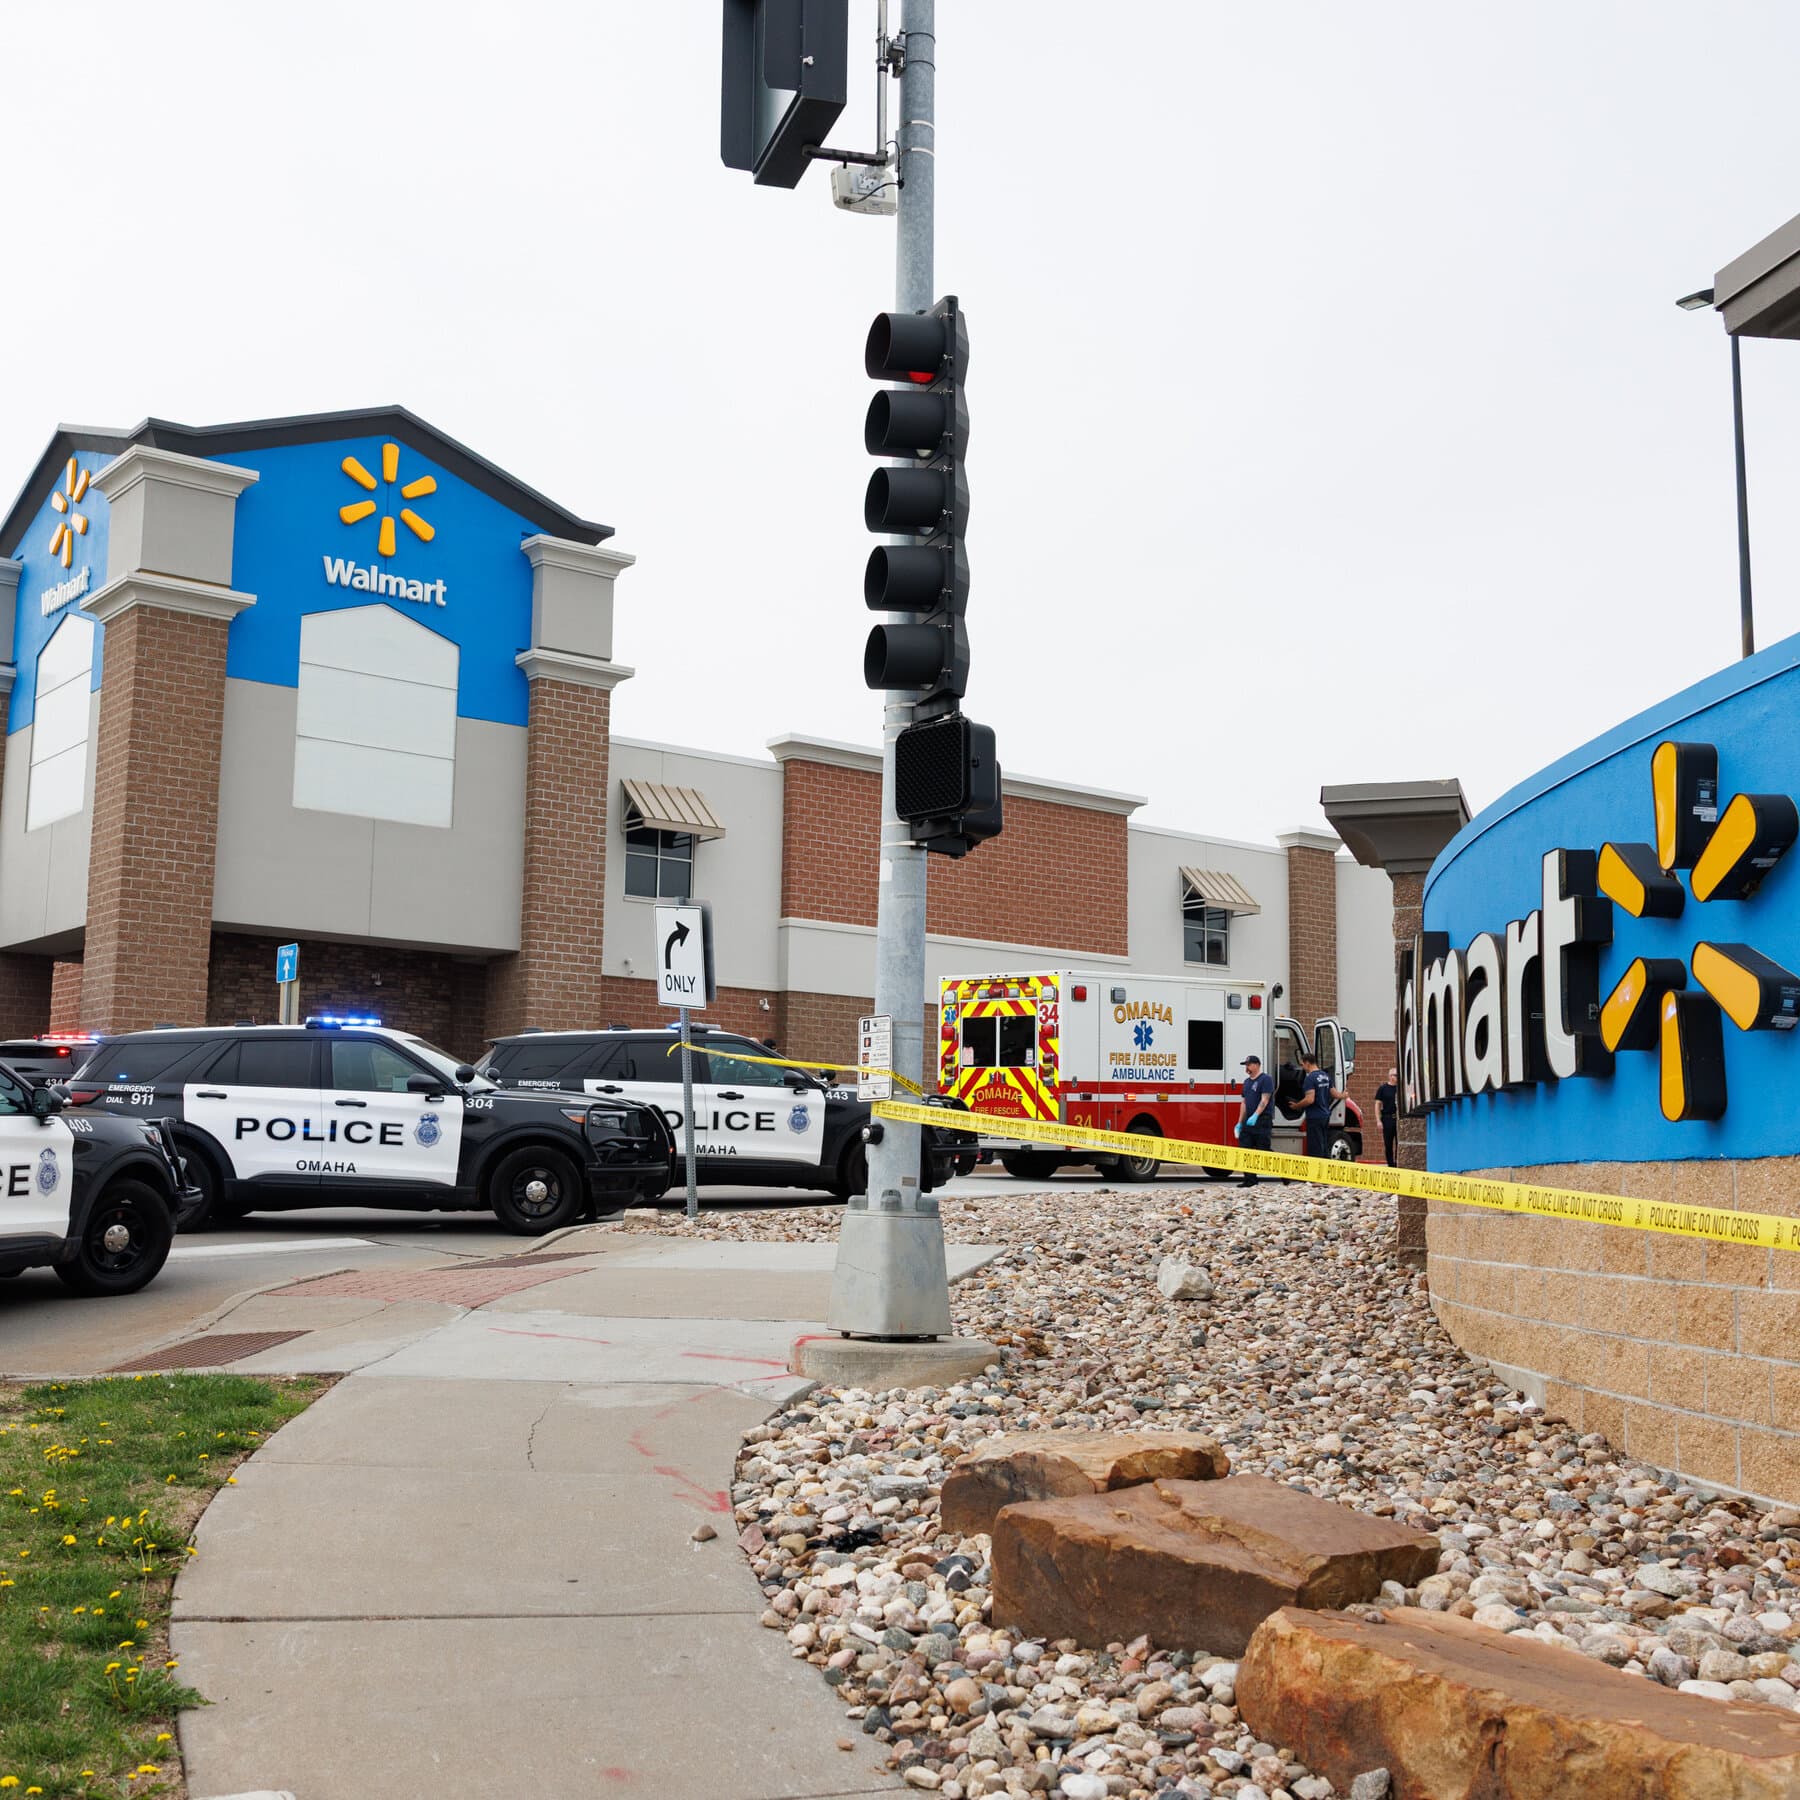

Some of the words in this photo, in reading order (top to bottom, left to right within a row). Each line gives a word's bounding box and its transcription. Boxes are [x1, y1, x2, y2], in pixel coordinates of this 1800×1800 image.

[322, 555, 447, 607] Walmart
[41, 565, 91, 617] Walmart
[665, 974, 696, 993] ONLY
[1396, 848, 1577, 1114] almart
[1039, 1003, 1059, 1024] 34
[1114, 1000, 1174, 1026] OMAHA
[1109, 1052, 1131, 1066] FIRE
[1138, 1052, 1177, 1067] RESCUE
[1112, 1068, 1175, 1081] AMBULANCE
[108, 1084, 156, 1092] EMERGENCY
[825, 1091, 849, 1101] 443
[976, 1087, 1020, 1104] OMAHA
[106, 1096, 124, 1104] DIAL
[130, 1093, 154, 1106] 911
[466, 1098, 494, 1109] 304
[975, 1106, 988, 1115] FIRE
[994, 1107, 1020, 1115] RESCUE
[68, 1118, 93, 1133] 403
[664, 1110, 776, 1132] OLICE
[1074, 1114, 1092, 1128] 34
[234, 1117, 404, 1146] POLICE
[695, 1144, 737, 1155] MAHA
[296, 1159, 357, 1174] OMAHA
[1243, 1153, 1260, 1169] POLICE
[1261, 1156, 1272, 1171] LINE
[1272, 1156, 1280, 1172] DO
[1281, 1158, 1292, 1174] NOT
[1292, 1160, 1309, 1177] CROSS
[1327, 1164, 1345, 1182] POLICE
[1346, 1167, 1358, 1184] LINE
[1359, 1169, 1367, 1185] DO
[1368, 1170, 1380, 1187] NOT
[1381, 1171, 1400, 1190] CROSS
[1420, 1176, 1442, 1196] POLICE
[1443, 1180, 1457, 1197] LINE
[1458, 1182, 1467, 1199] DO
[1468, 1183, 1482, 1201] NOT
[1482, 1185, 1504, 1205] CROSS
[1528, 1190, 1552, 1212] POLICE
[1553, 1195, 1568, 1214] LINE
[1570, 1197, 1580, 1215] DO
[1582, 1198, 1597, 1217] NOT
[1598, 1200, 1623, 1222] CROSS
[1650, 1206, 1678, 1228] POLICE
[1678, 1212, 1696, 1232] LINE
[1698, 1213, 1710, 1233] DO
[1712, 1215, 1730, 1236] NOT
[1731, 1217, 1760, 1240] CROSS
